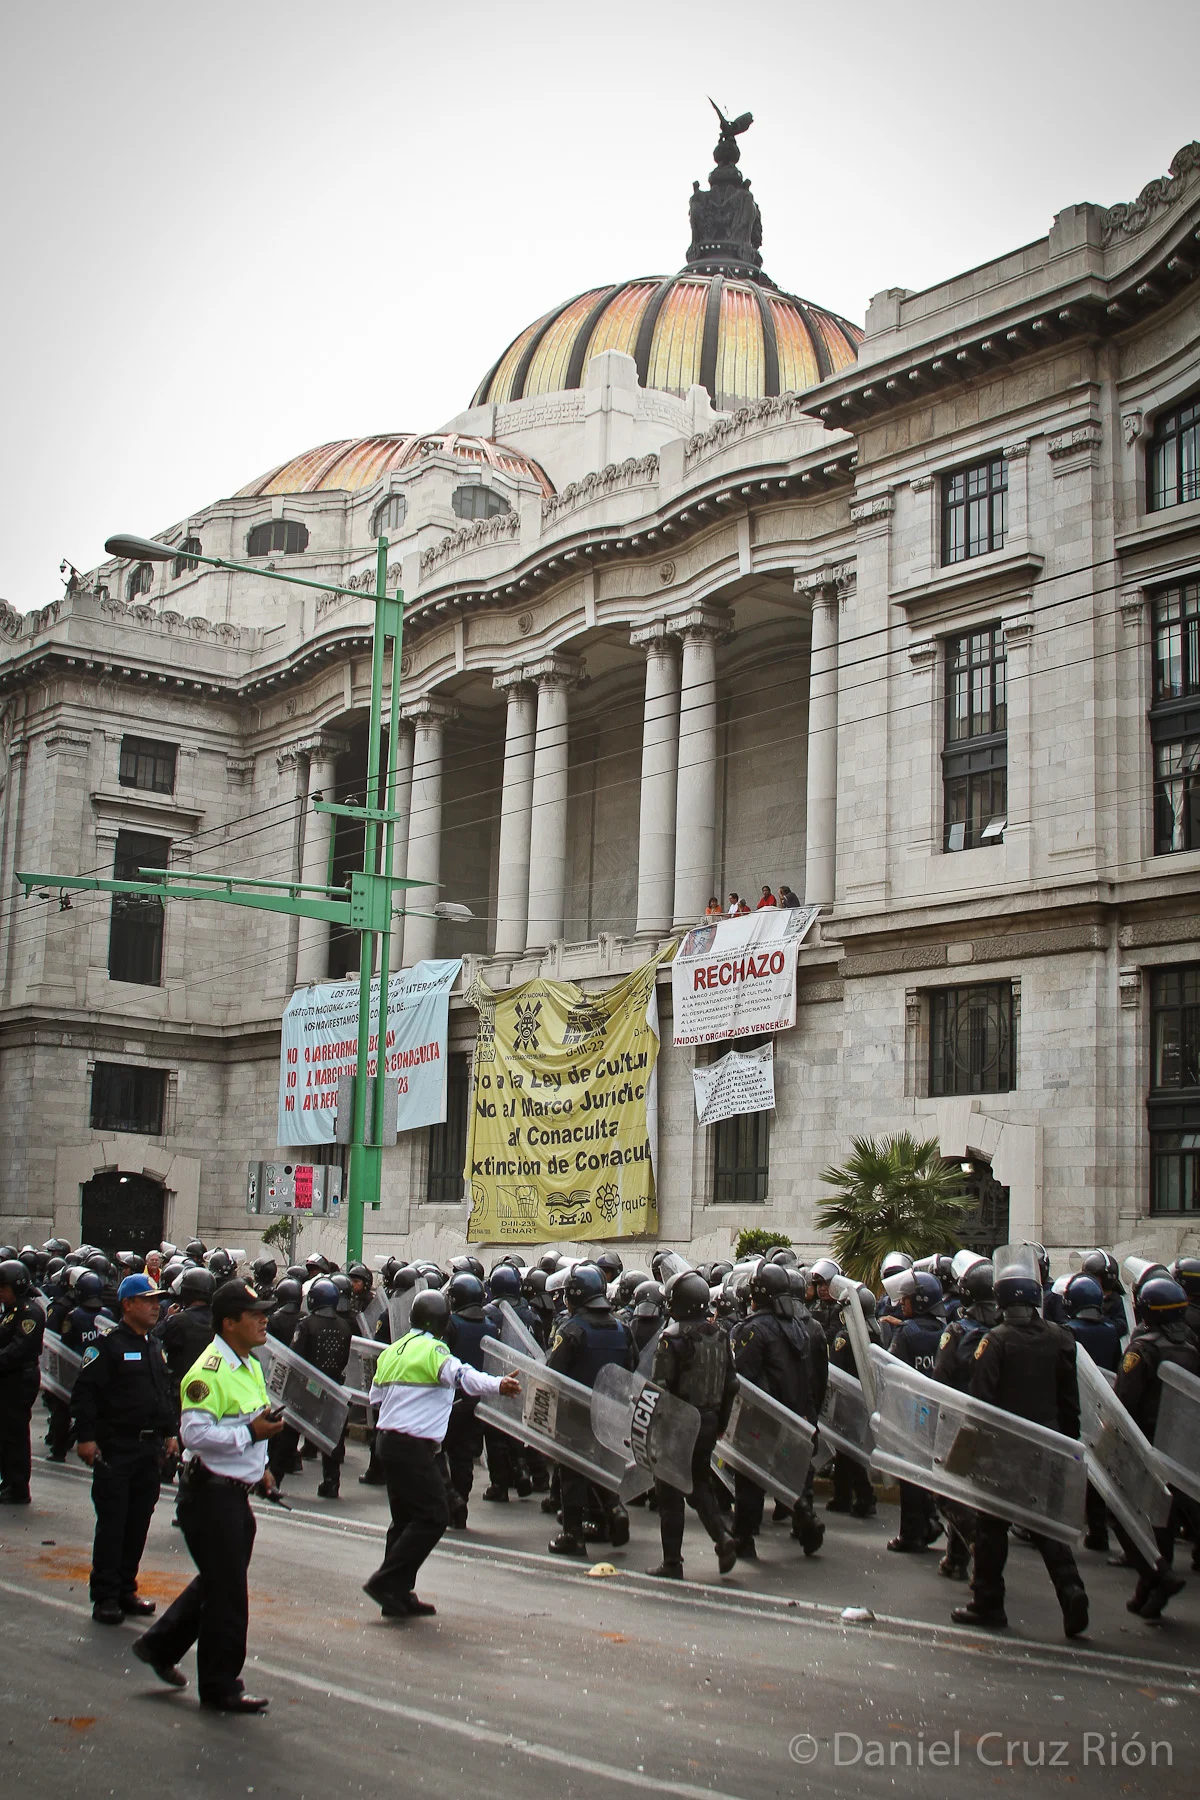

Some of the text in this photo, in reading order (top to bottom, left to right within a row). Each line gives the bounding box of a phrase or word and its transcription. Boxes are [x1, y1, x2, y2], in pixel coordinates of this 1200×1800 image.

[694, 951, 784, 991] RECHAZO
[331, 990, 343, 999] LOS
[689, 992, 708, 1000] MARCO
[699, 1034, 704, 1042] Y
[705, 1026, 749, 1041] ORGANIZADOS
[287, 1047, 298, 1064] NO
[287, 1071, 297, 1088] NO
[314, 1066, 342, 1086] MARCO
[391, 1041, 440, 1071] CONACULTA
[496, 1075, 504, 1089] a
[508, 1070, 523, 1088] la
[531, 1069, 561, 1092] Ley
[567, 1065, 591, 1084] de
[285, 1095, 295, 1111] NO
[476, 1098, 496, 1118] No
[503, 1098, 516, 1117] al
[522, 1097, 573, 1117] Marco
[508, 1118, 619, 1146] al Conaculta
[547, 1154, 570, 1175] de
[271, 1361, 287, 1394] POLICIA
[533, 1387, 551, 1428] POLICIA
[631, 1389, 660, 1470] POLICIA
